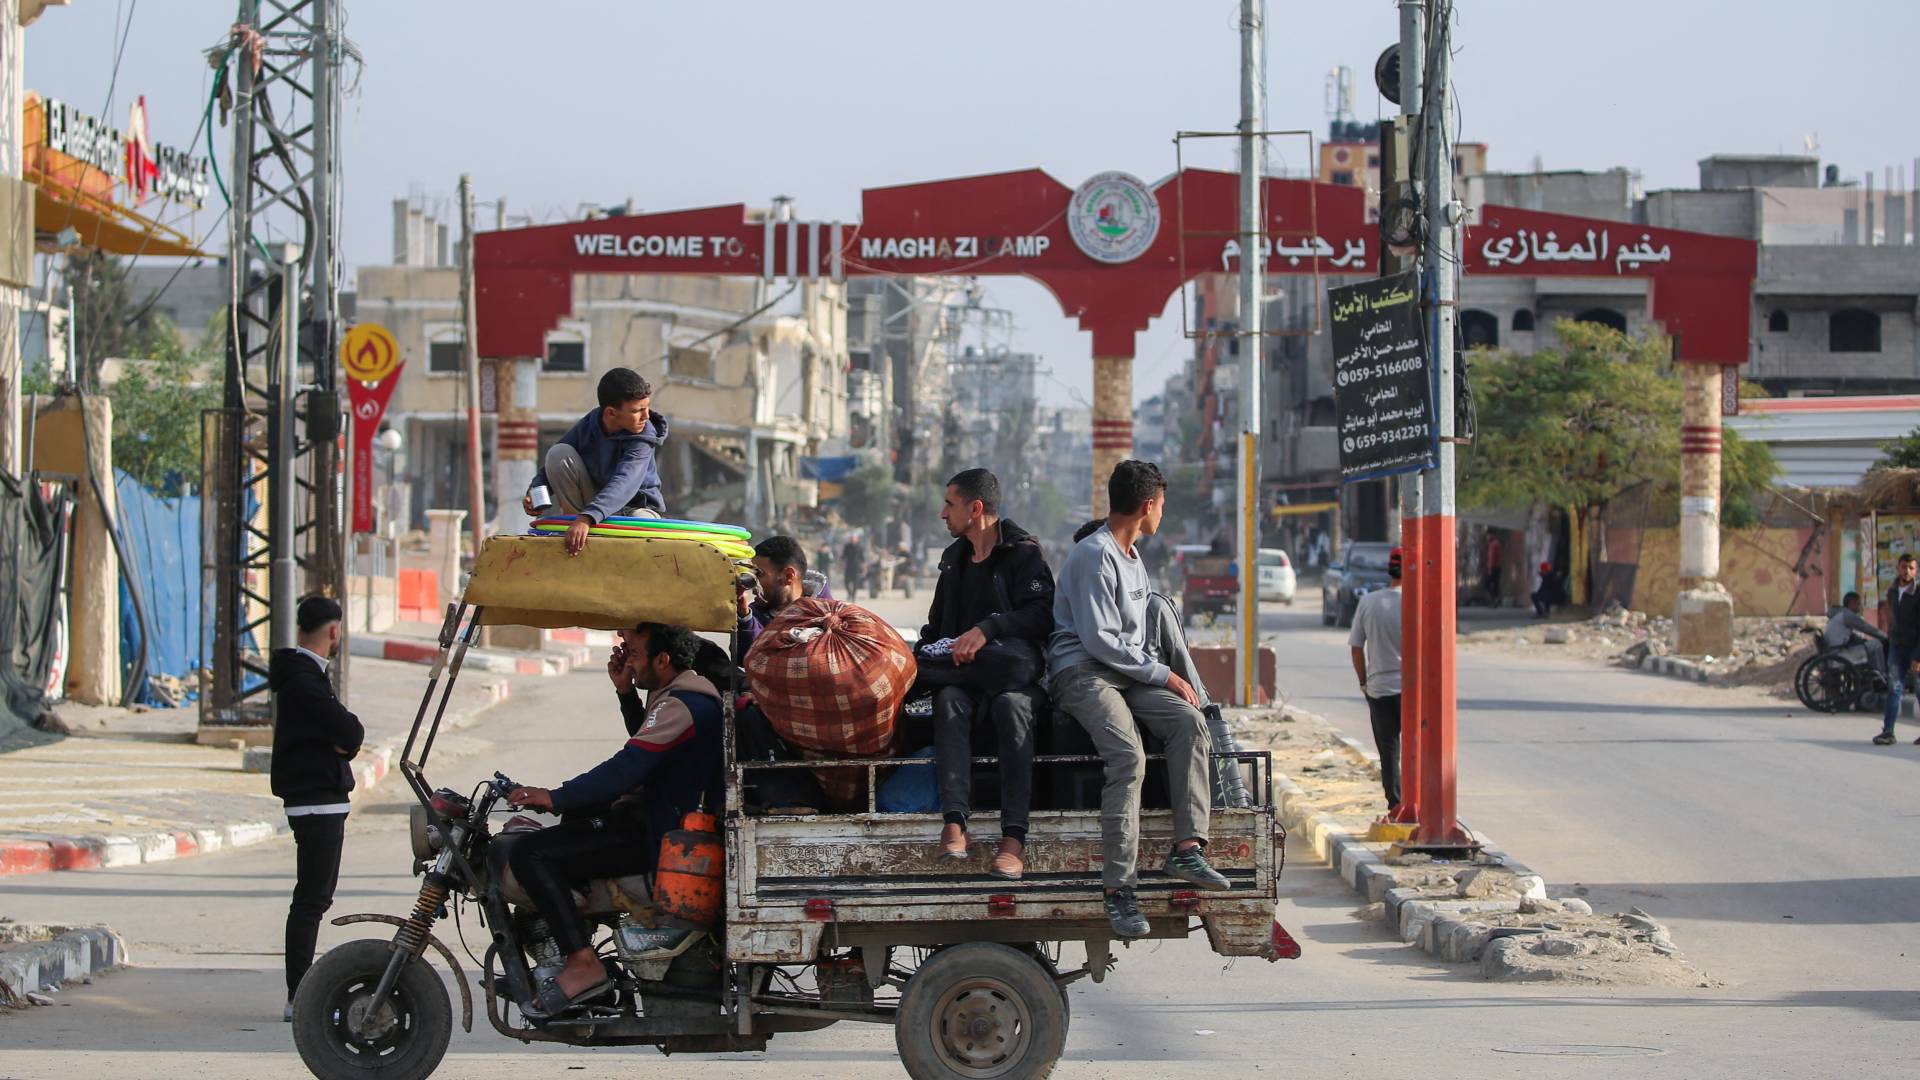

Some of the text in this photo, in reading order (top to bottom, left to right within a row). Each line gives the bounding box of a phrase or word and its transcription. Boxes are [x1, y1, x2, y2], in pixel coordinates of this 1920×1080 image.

[575, 235, 743, 257] WELCOME TO
[861, 236, 978, 258] MAGHAZI
[1276, 232, 1366, 268] يرحب
[1482, 228, 1671, 273] مخيم المغازي
[1333, 286, 1414, 322] مكتب الأمين
[1372, 343, 1394, 361] حسن
[1396, 337, 1419, 353] محمد
[1349, 356, 1423, 384] 059-5166008
[1380, 408, 1404, 422] محمد
[1404, 403, 1425, 423] أيوب
[1356, 423, 1429, 450] 059-9342291
